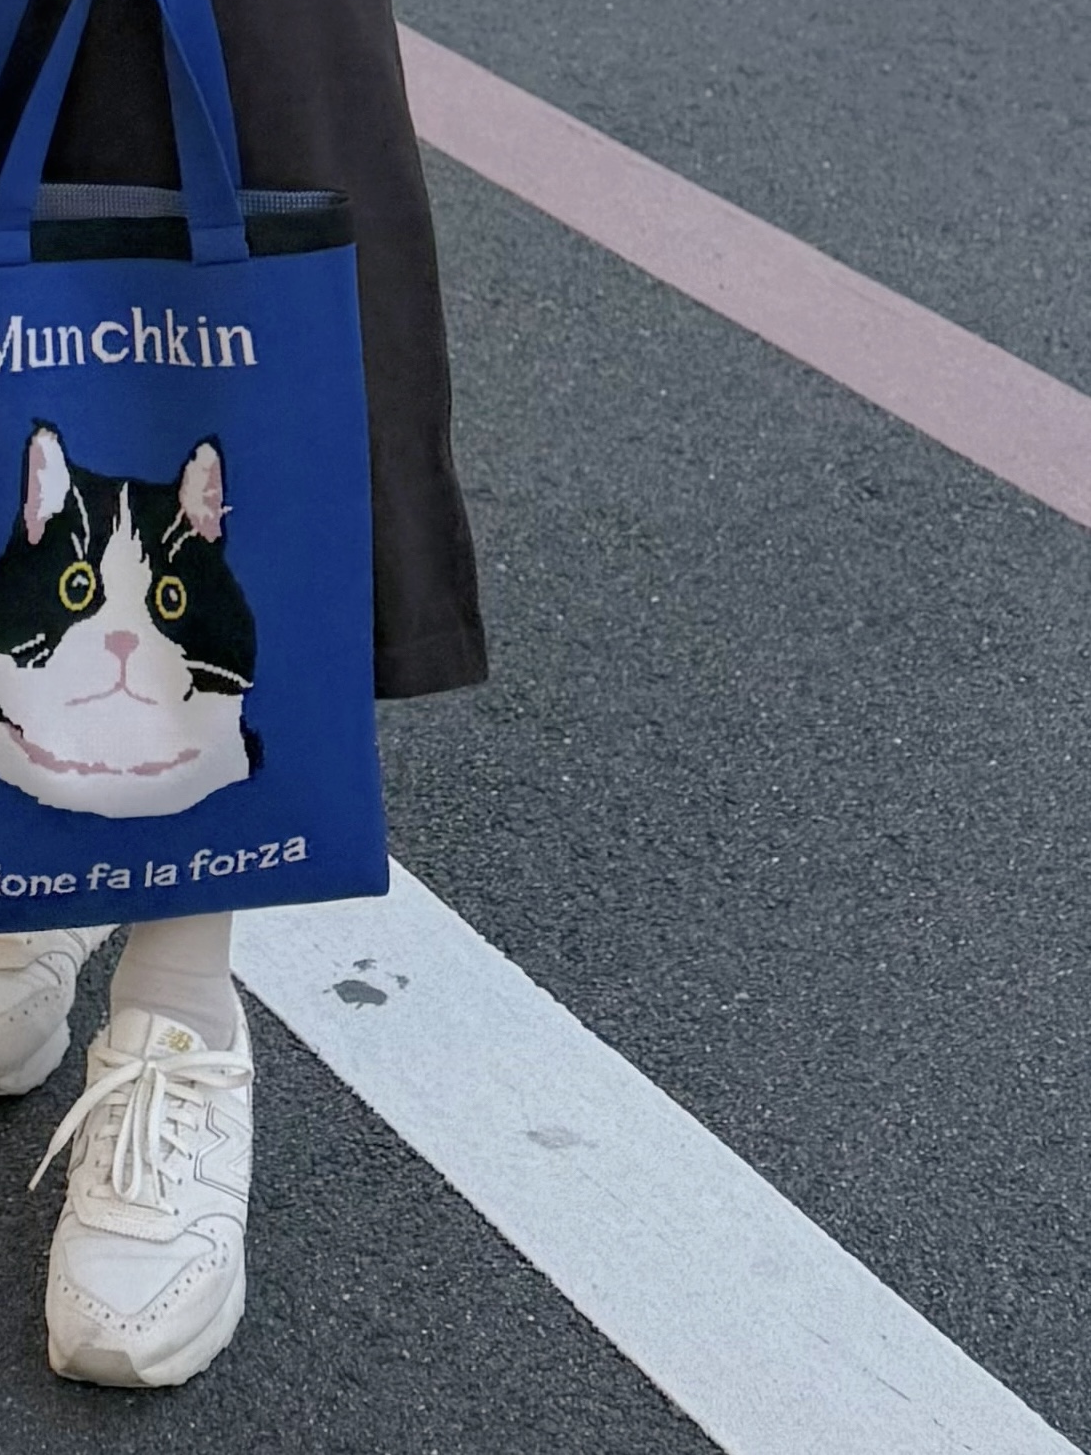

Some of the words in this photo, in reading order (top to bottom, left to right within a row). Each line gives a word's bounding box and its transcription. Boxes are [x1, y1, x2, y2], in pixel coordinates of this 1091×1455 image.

[86, 863, 131, 890] fa
[144, 861, 178, 887] la
[189, 835, 307, 882] forza
